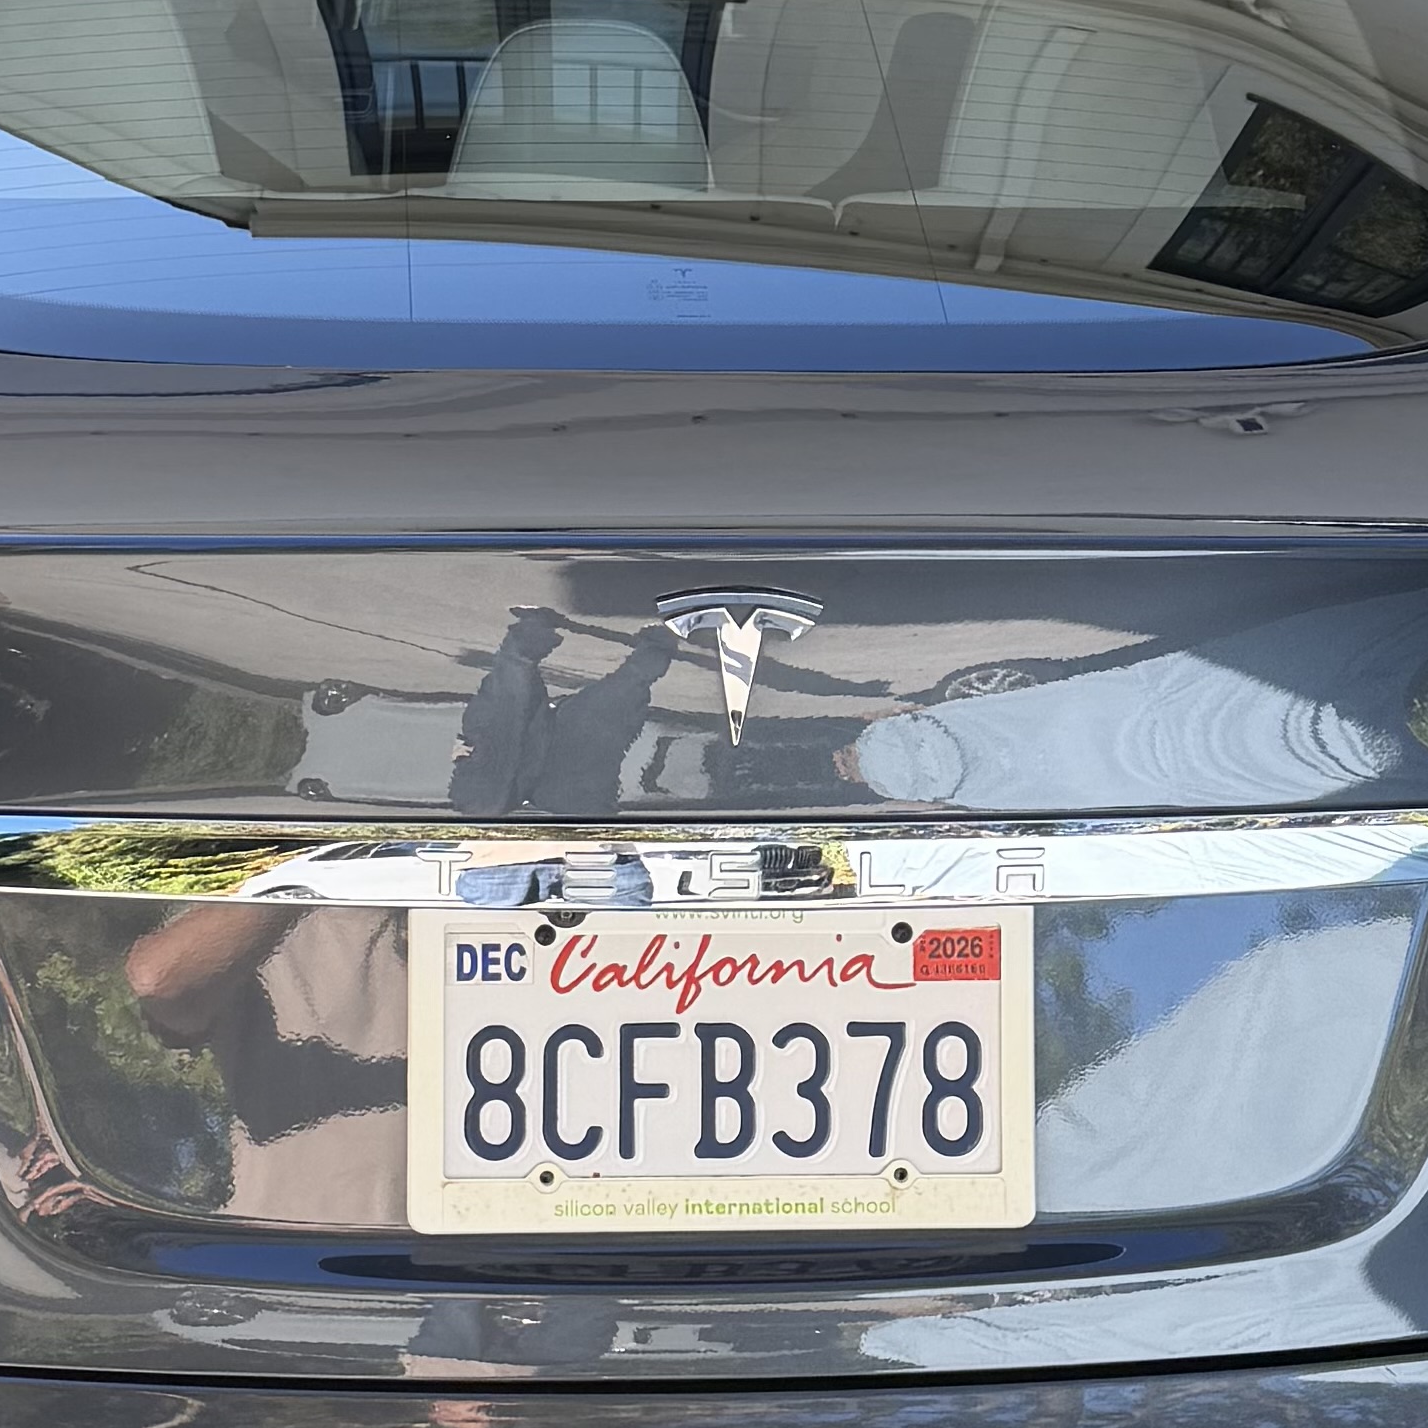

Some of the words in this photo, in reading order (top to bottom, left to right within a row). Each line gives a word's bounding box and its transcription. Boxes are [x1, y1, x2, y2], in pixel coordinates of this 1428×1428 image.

[415, 846, 1046, 900] TESLA
[456, 943, 527, 982] DEC
[928, 935, 984, 959] 2026
[551, 934, 917, 1014] California
[463, 1021, 984, 1160] 8CFB378
[553, 1199, 617, 1217] silicon
[623, 1199, 679, 1219] valley
[684, 1197, 825, 1215] international
[830, 1196, 897, 1214] school
